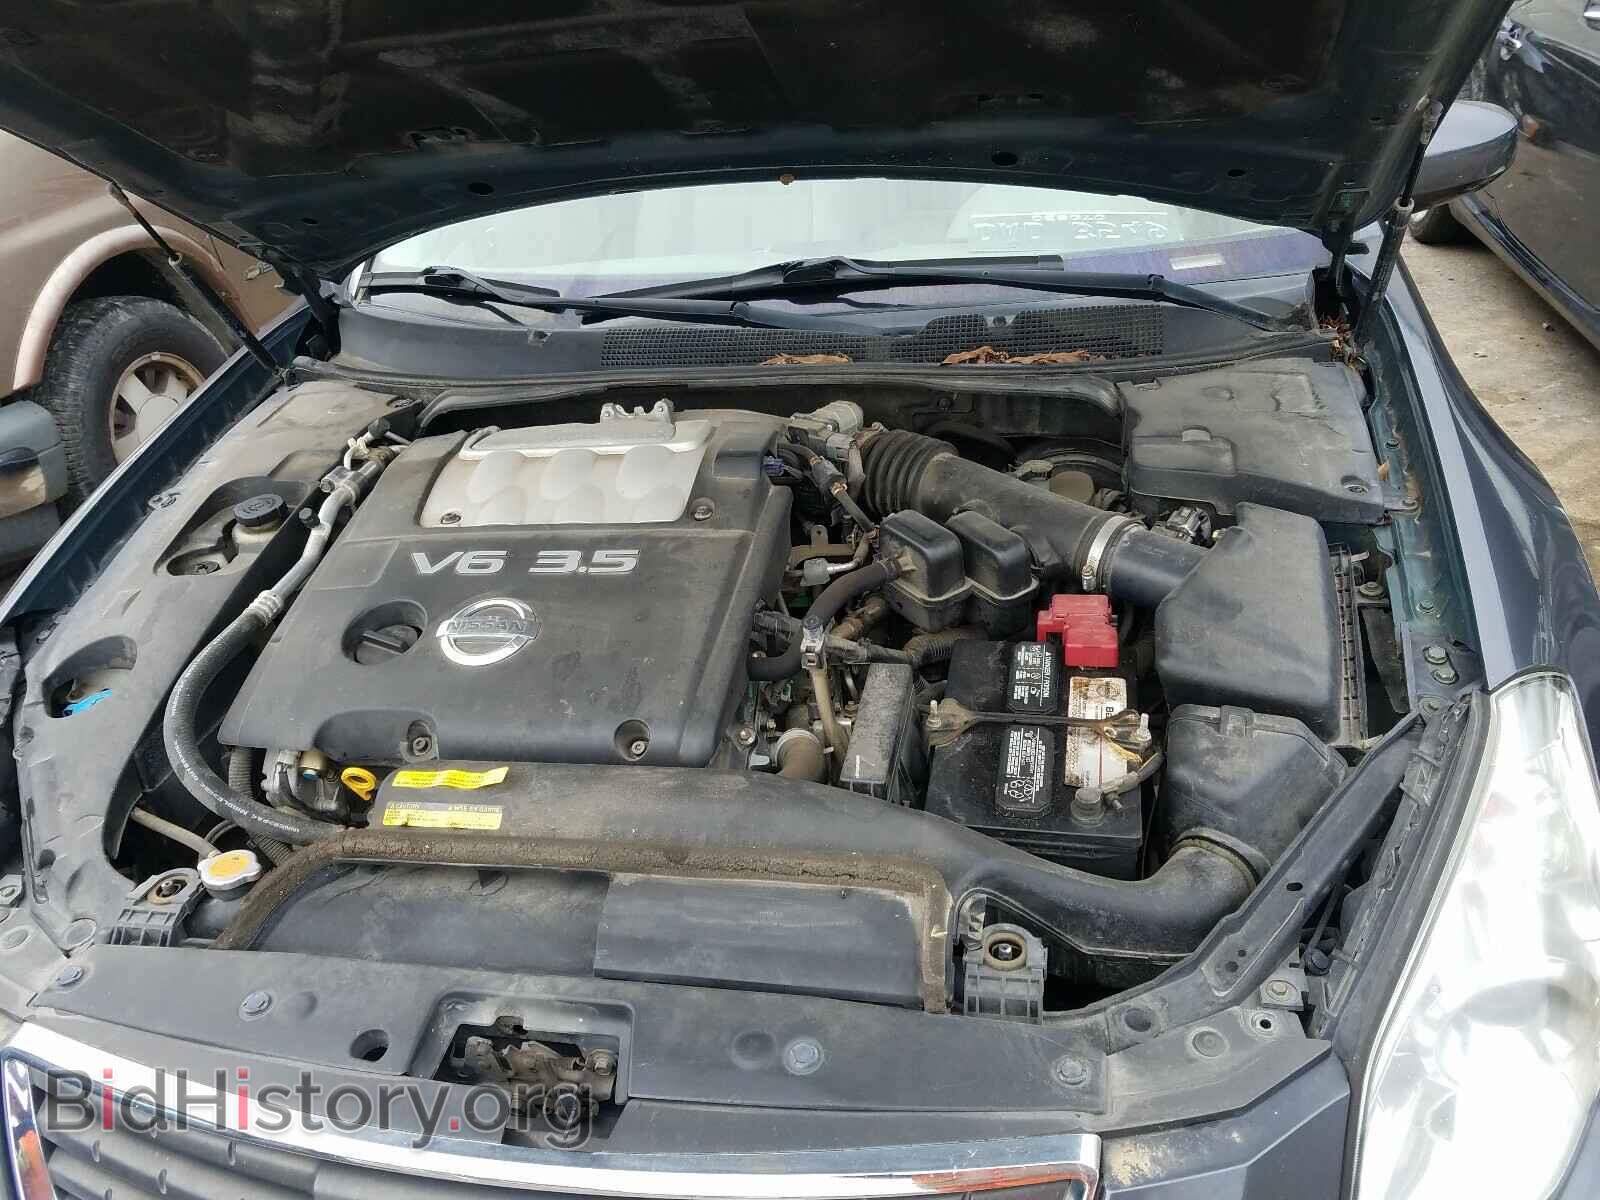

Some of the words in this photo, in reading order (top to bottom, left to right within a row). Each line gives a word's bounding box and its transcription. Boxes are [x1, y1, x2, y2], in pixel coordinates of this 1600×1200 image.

[411, 549, 509, 575] V6
[528, 549, 640, 575] 3.5
[447, 619, 526, 634] NISSAN
[1044, 656, 1052, 675] DANGER
[1043, 679, 1051, 698] POISON
